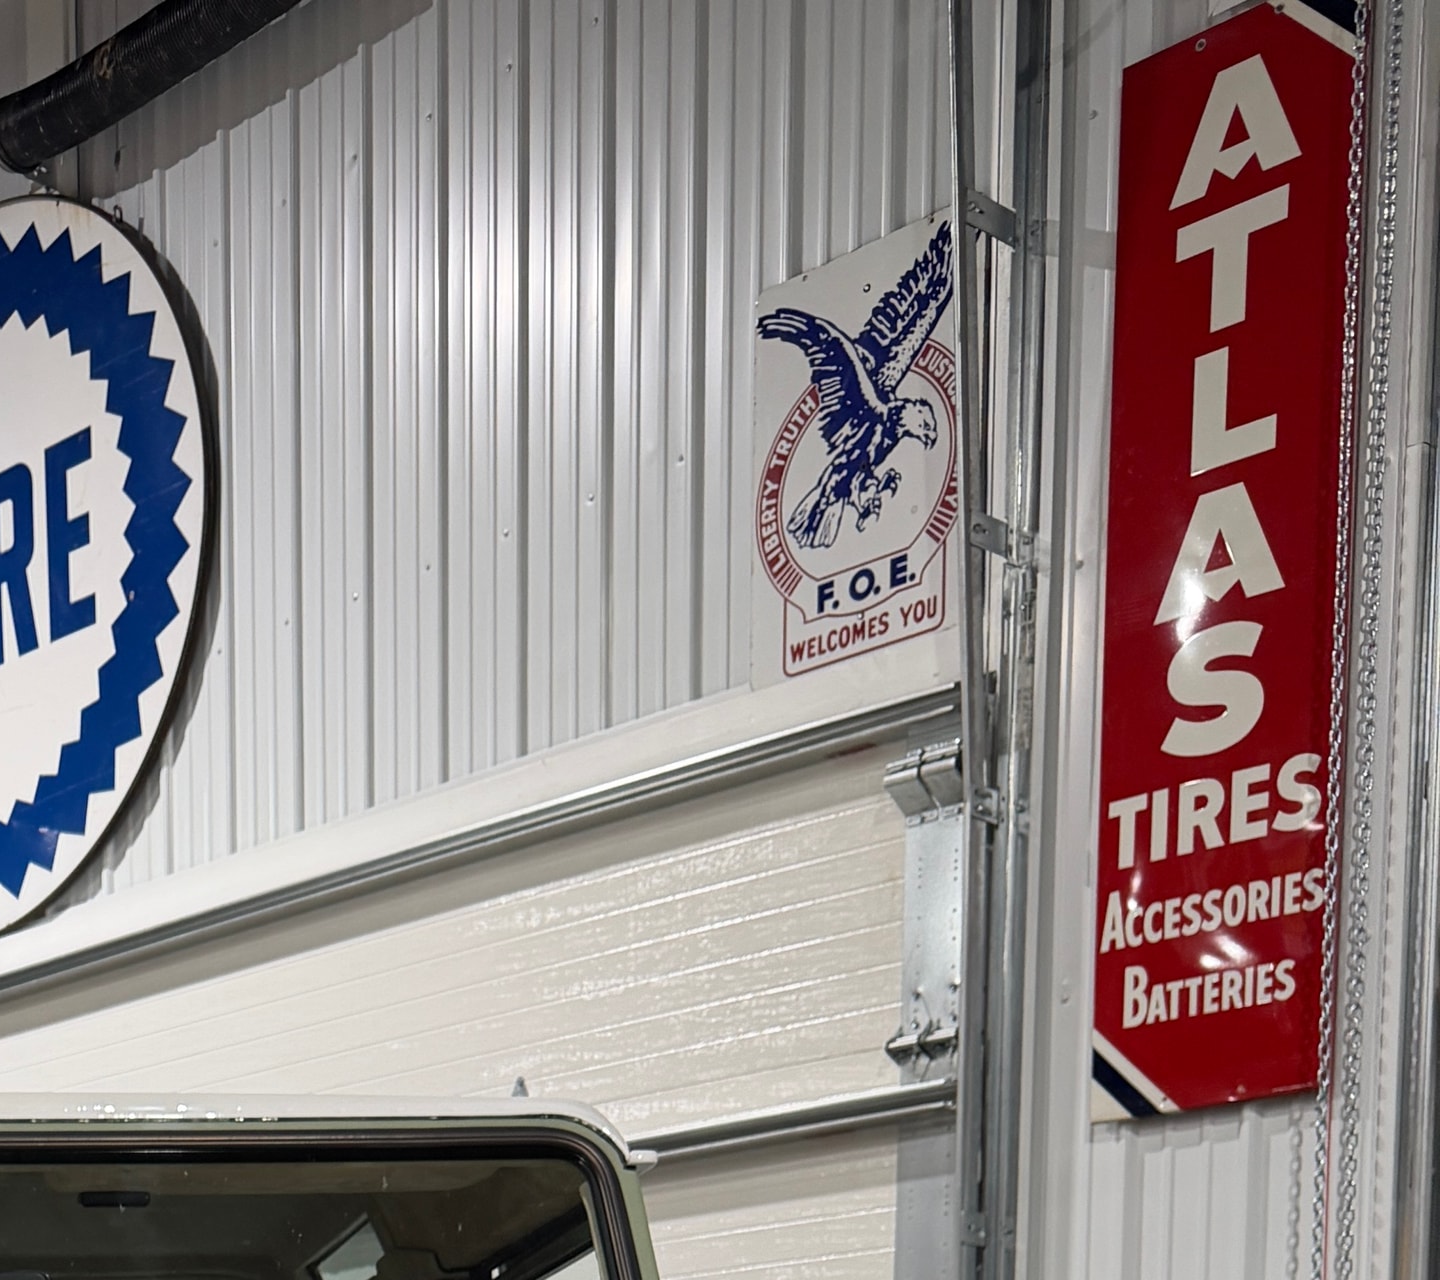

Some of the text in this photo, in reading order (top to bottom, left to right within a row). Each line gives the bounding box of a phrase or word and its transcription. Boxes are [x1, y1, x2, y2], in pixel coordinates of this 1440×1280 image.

[1153, 53, 1302, 757] ATLAS
[761, 394, 817, 574] LIBERTY TRUTH
[789, 594, 938, 664] WELCOMES YOU
[1108, 752, 1323, 871] TIRES
